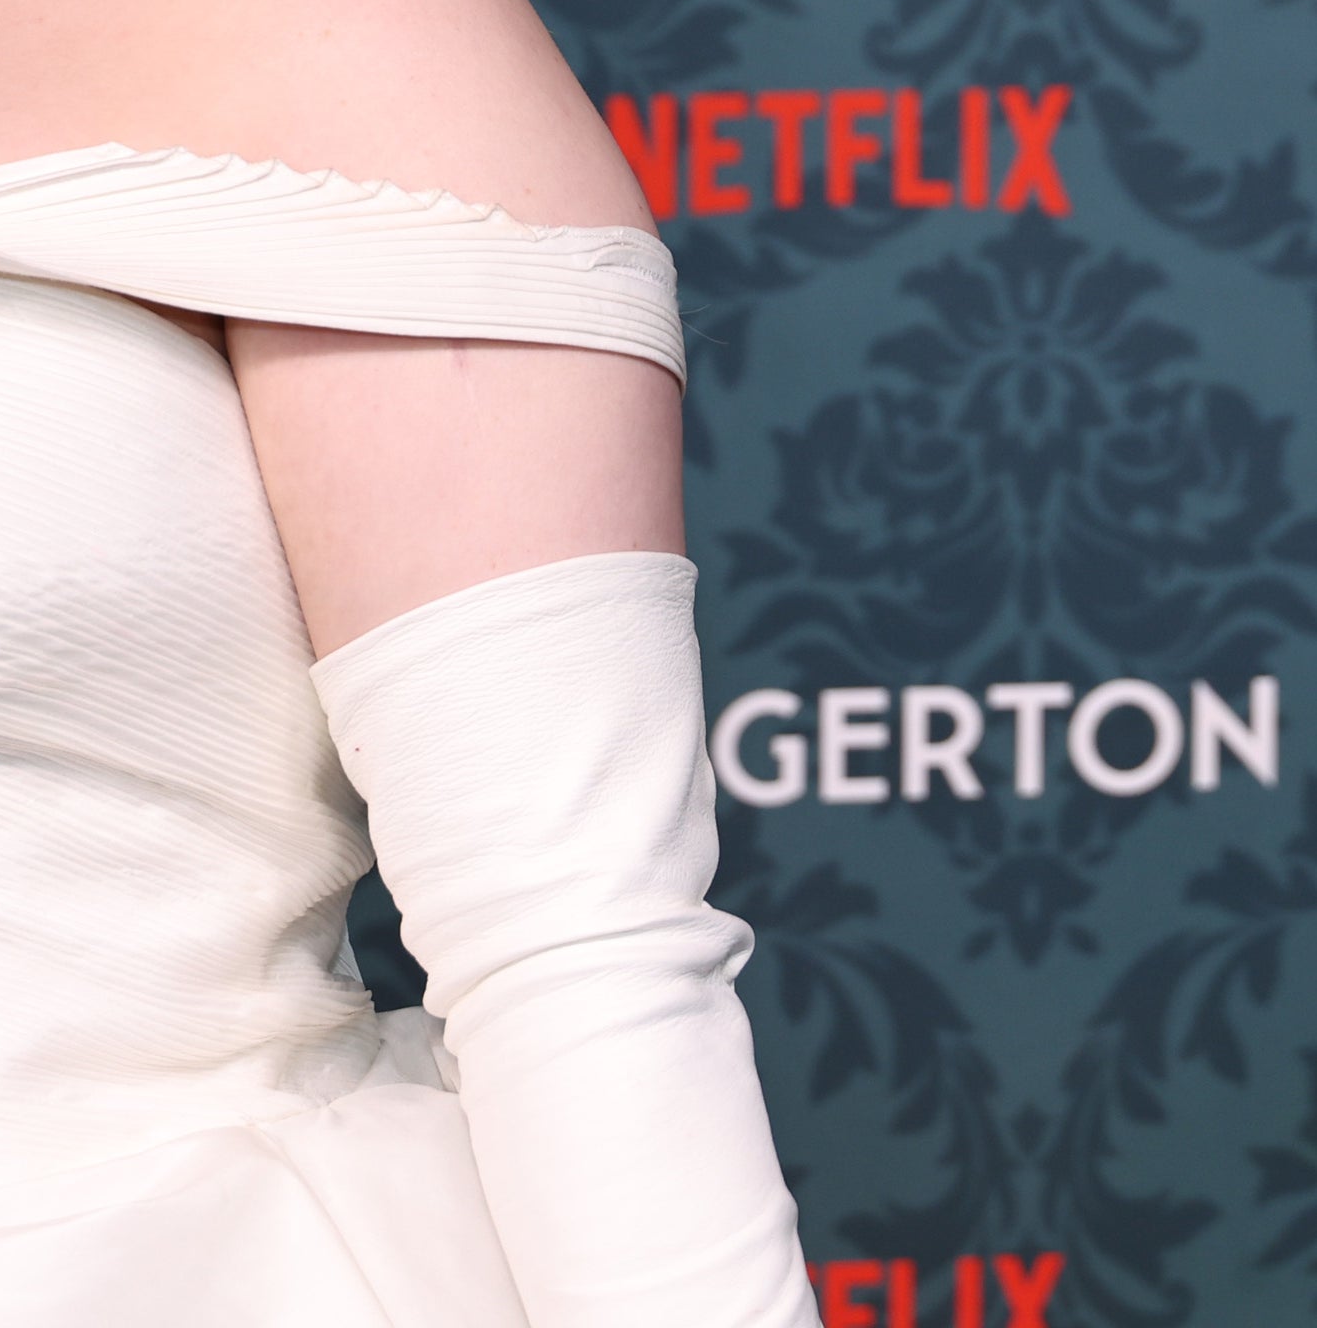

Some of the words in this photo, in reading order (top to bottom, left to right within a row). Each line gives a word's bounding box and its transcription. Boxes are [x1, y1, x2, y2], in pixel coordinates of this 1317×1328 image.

[606, 85, 1071, 220] NETFLIX
[711, 676, 1279, 807] GERTON
[806, 1253, 1063, 1328] FLIX
